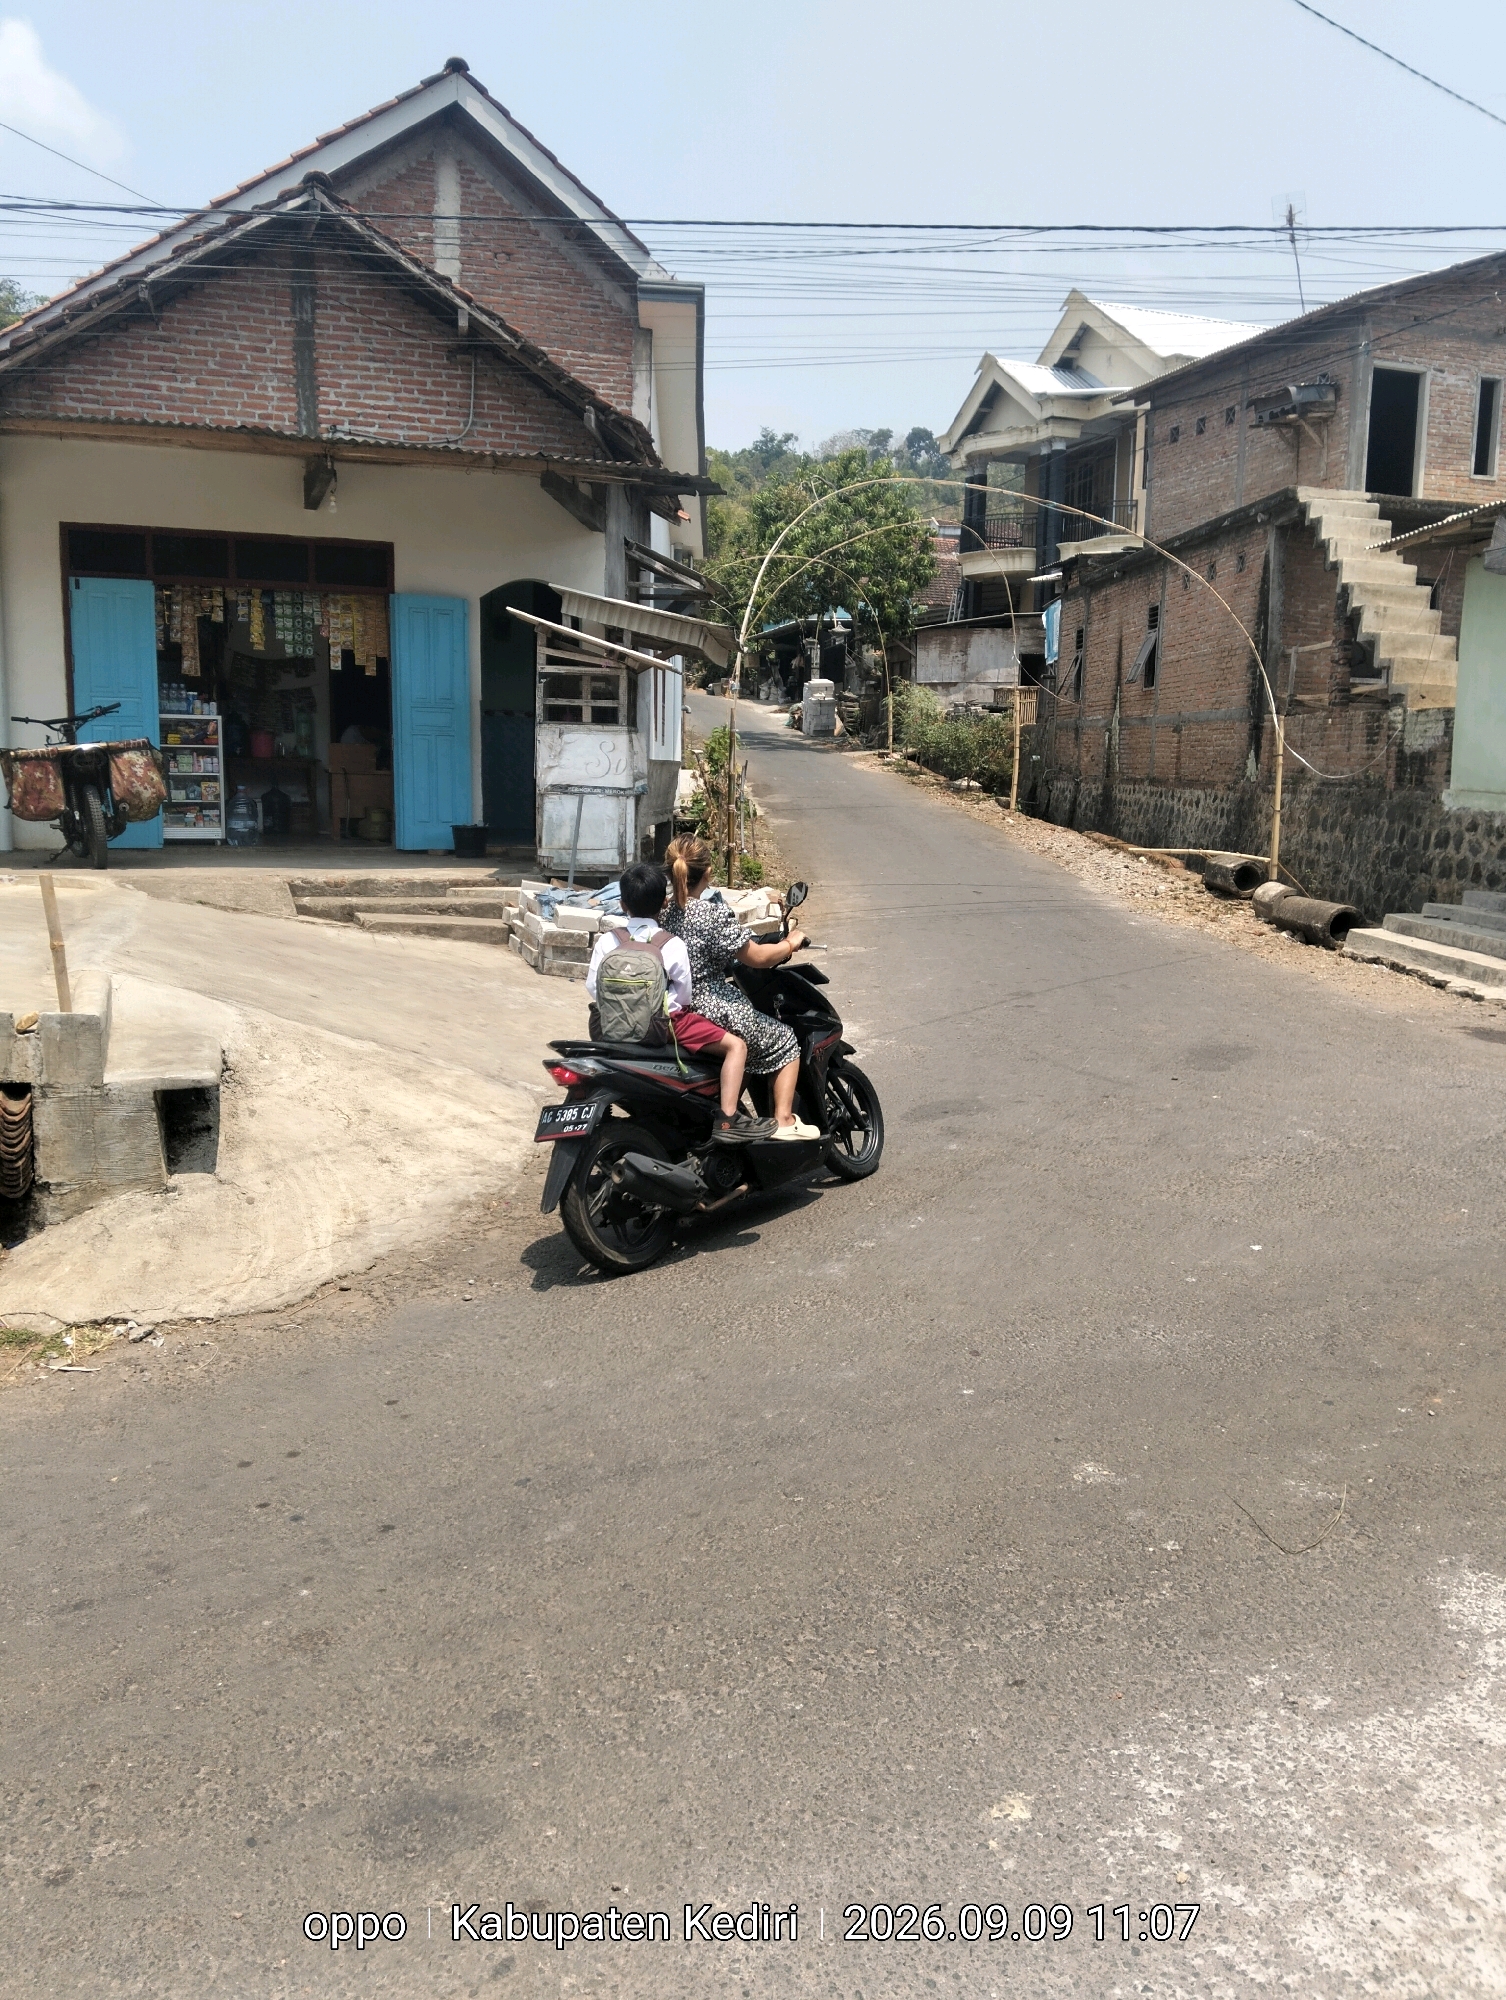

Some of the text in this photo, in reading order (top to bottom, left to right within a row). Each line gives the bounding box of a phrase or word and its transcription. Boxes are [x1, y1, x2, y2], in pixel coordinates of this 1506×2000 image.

[541, 1106, 594, 1124] AG 5385 CJ
